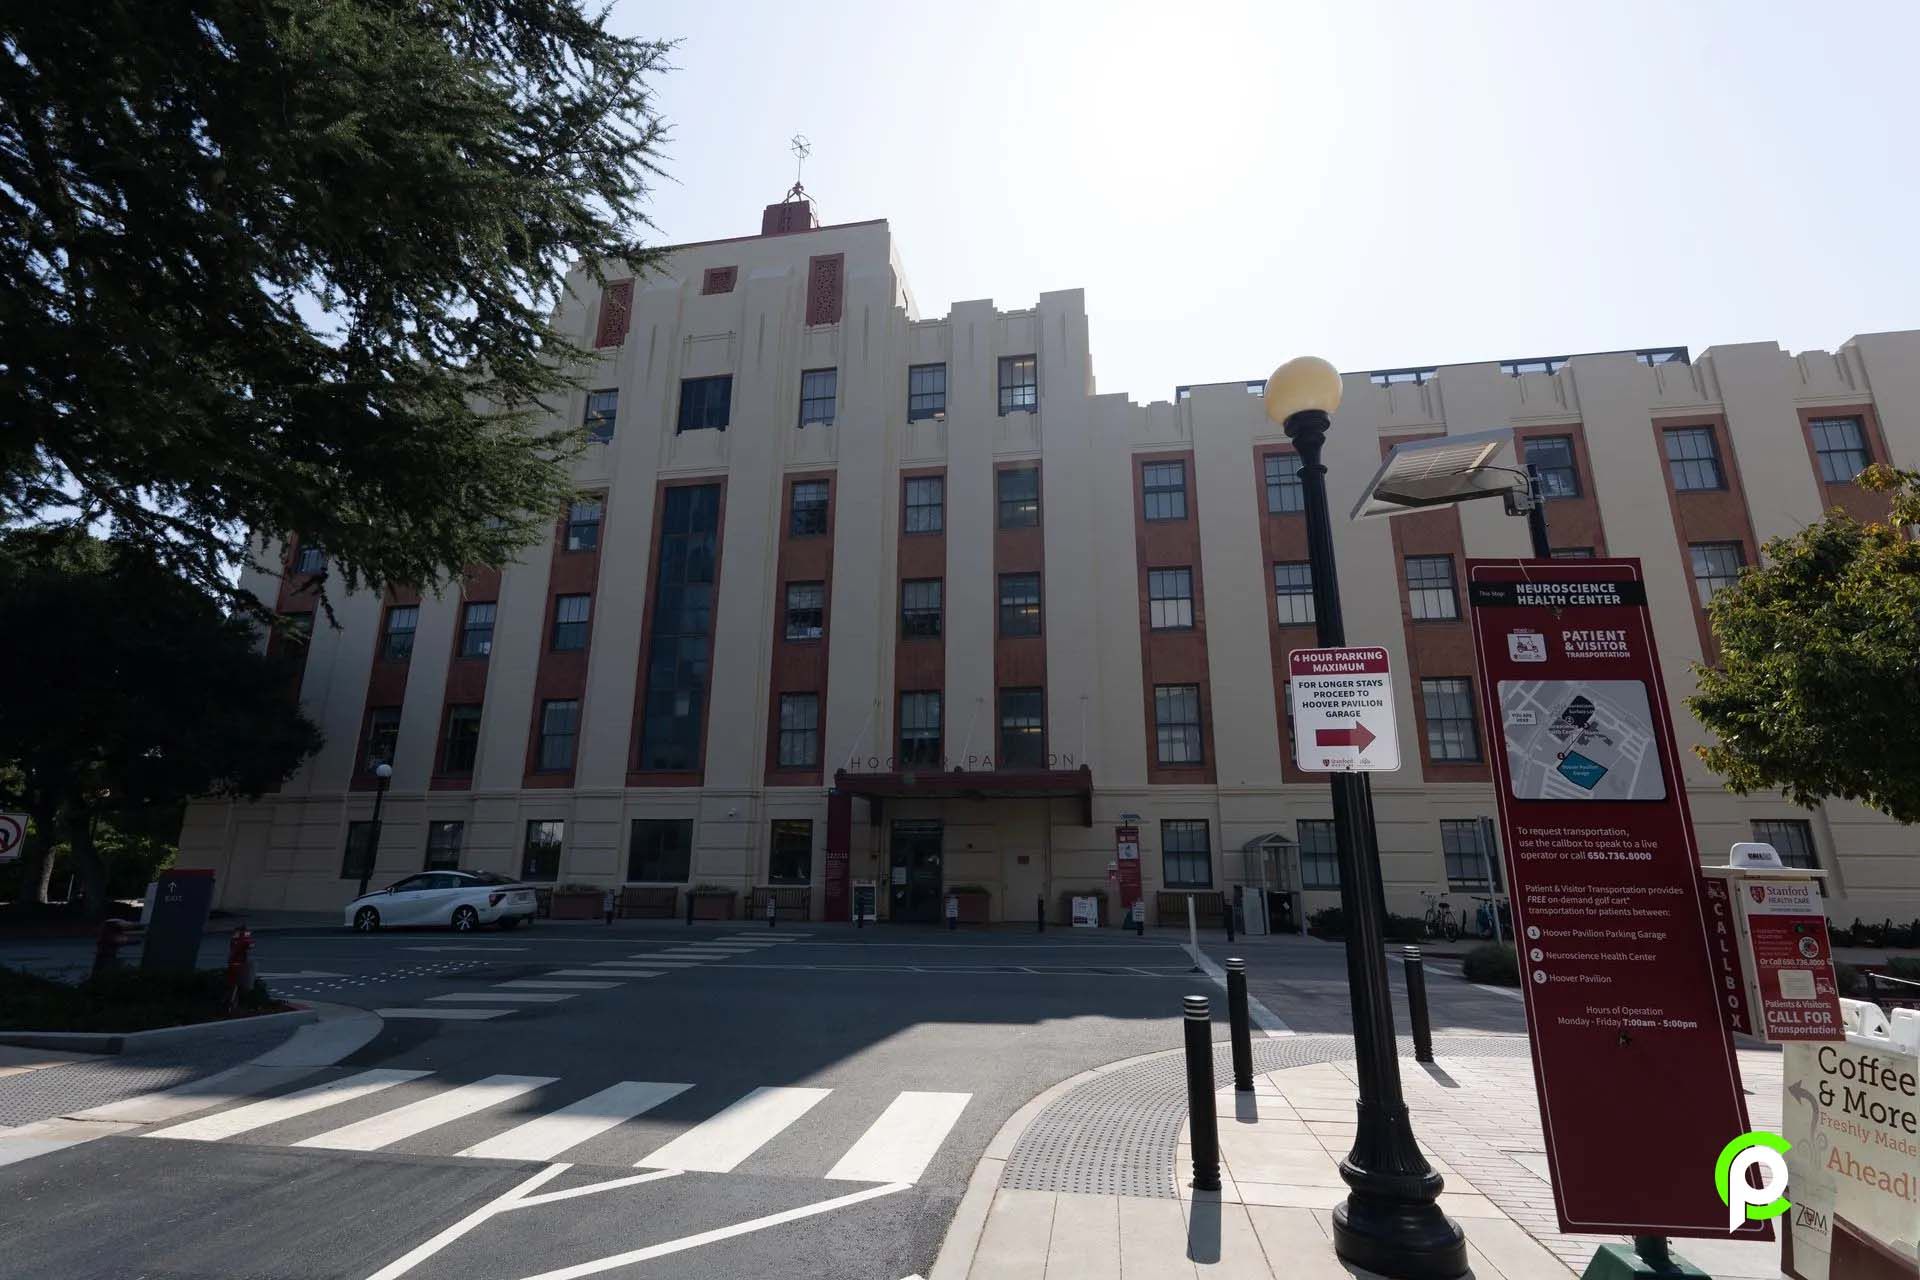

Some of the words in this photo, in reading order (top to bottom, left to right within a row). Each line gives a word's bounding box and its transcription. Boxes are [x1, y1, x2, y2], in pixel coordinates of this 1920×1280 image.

[1516, 583, 1616, 594] NEUROSCIENCE
[1518, 595, 1566, 605] HEALTH
[1570, 595, 1621, 605] CENTER
[1562, 630, 1626, 641] PATIENT
[1564, 642, 1574, 651] &
[1576, 642, 1628, 651] VISITOR
[1302, 654, 1333, 662] HOUR
[1335, 651, 1382, 661] PARKING
[1312, 663, 1365, 672] MAXIMUM
[1318, 680, 1354, 688] LONGER
[1302, 700, 1339, 708] HOOVER
[1341, 700, 1383, 708] PAVILION
[1326, 710, 1362, 718] GARAGE
[1518, 827, 1528, 835] To
[1530, 827, 1561, 837] request
[1563, 828, 1630, 838] transportation,
[1552, 840, 1582, 848] callbox
[1595, 840, 1621, 850] speak
[1641, 840, 1658, 848] live
[1521, 853, 1557, 861] operator
[1571, 852, 1586, 860] call
[1526, 885, 1553, 893] Patient
[1561, 885, 1586, 893] Visitor
[1588, 886, 1646, 895] Transportation
[1648, 886, 1684, 896] provides
[1766, 886, 1808, 897] Stanford
[1595, 896, 1610, 906] golf
[1768, 896, 1792, 905] HEALTH
[1794, 896, 1810, 905] CARE
[1529, 908, 1584, 916] transportation
[1599, 908, 1631, 916] patients
[1572, 928, 1604, 937] Pavilion
[1606, 930, 1637, 940] Parking
[1638, 930, 1667, 940] Garage
[1546, 952, 1600, 960] Neuroscience
[1601, 952, 1628, 961] Health
[1628, 952, 1656, 961] Center
[1549, 974, 1578, 982] Hoover
[1580, 974, 1612, 983] Pavilion
[1765, 1000, 1795, 1009] Patients
[1796, 1001, 1802, 1009] &
[1586, 1006, 1610, 1014] Hours
[1612, 1006, 1620, 1014] of
[1622, 1006, 1663, 1016] Operation
[1768, 1011, 1802, 1024] CALL
[1804, 1011, 1833, 1024] FOR
[1558, 1017, 1590, 1026] Monday
[1597, 1018, 1622, 1027] Friday
[1623, 1018, 1656, 1027] 7:00am
[1663, 1020, 1697, 1029] 5:00pm
[1769, 1025, 1836, 1036] Transportation
[1818, 1046, 1916, 1096] Coffee
[1819, 1080, 1836, 1107] &
[1842, 1086, 1918, 1134] More
[1820, 1112, 1872, 1145] Freshly
[1874, 1132, 1918, 1157] Made
[1826, 1146, 1919, 1202] Ahead!
